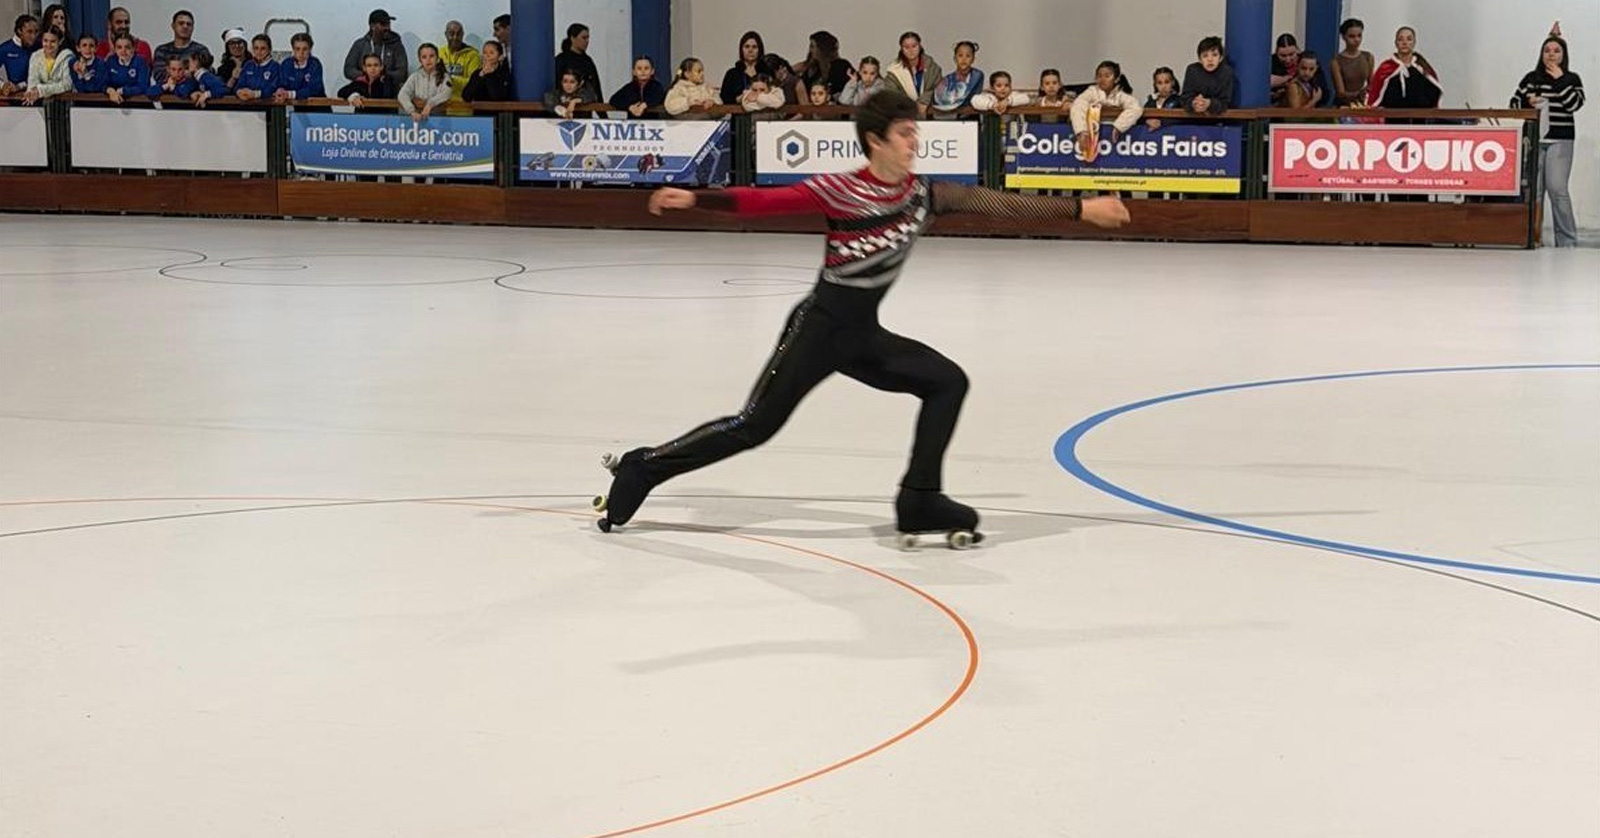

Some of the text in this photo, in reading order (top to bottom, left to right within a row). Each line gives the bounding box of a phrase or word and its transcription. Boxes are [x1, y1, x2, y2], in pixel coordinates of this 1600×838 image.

[592, 122, 664, 141] NMix
[321, 147, 464, 161] Loja Online de Ortopedia e Geriatria
[1116, 135, 1158, 155] das
[1161, 136, 1227, 157] Faias
